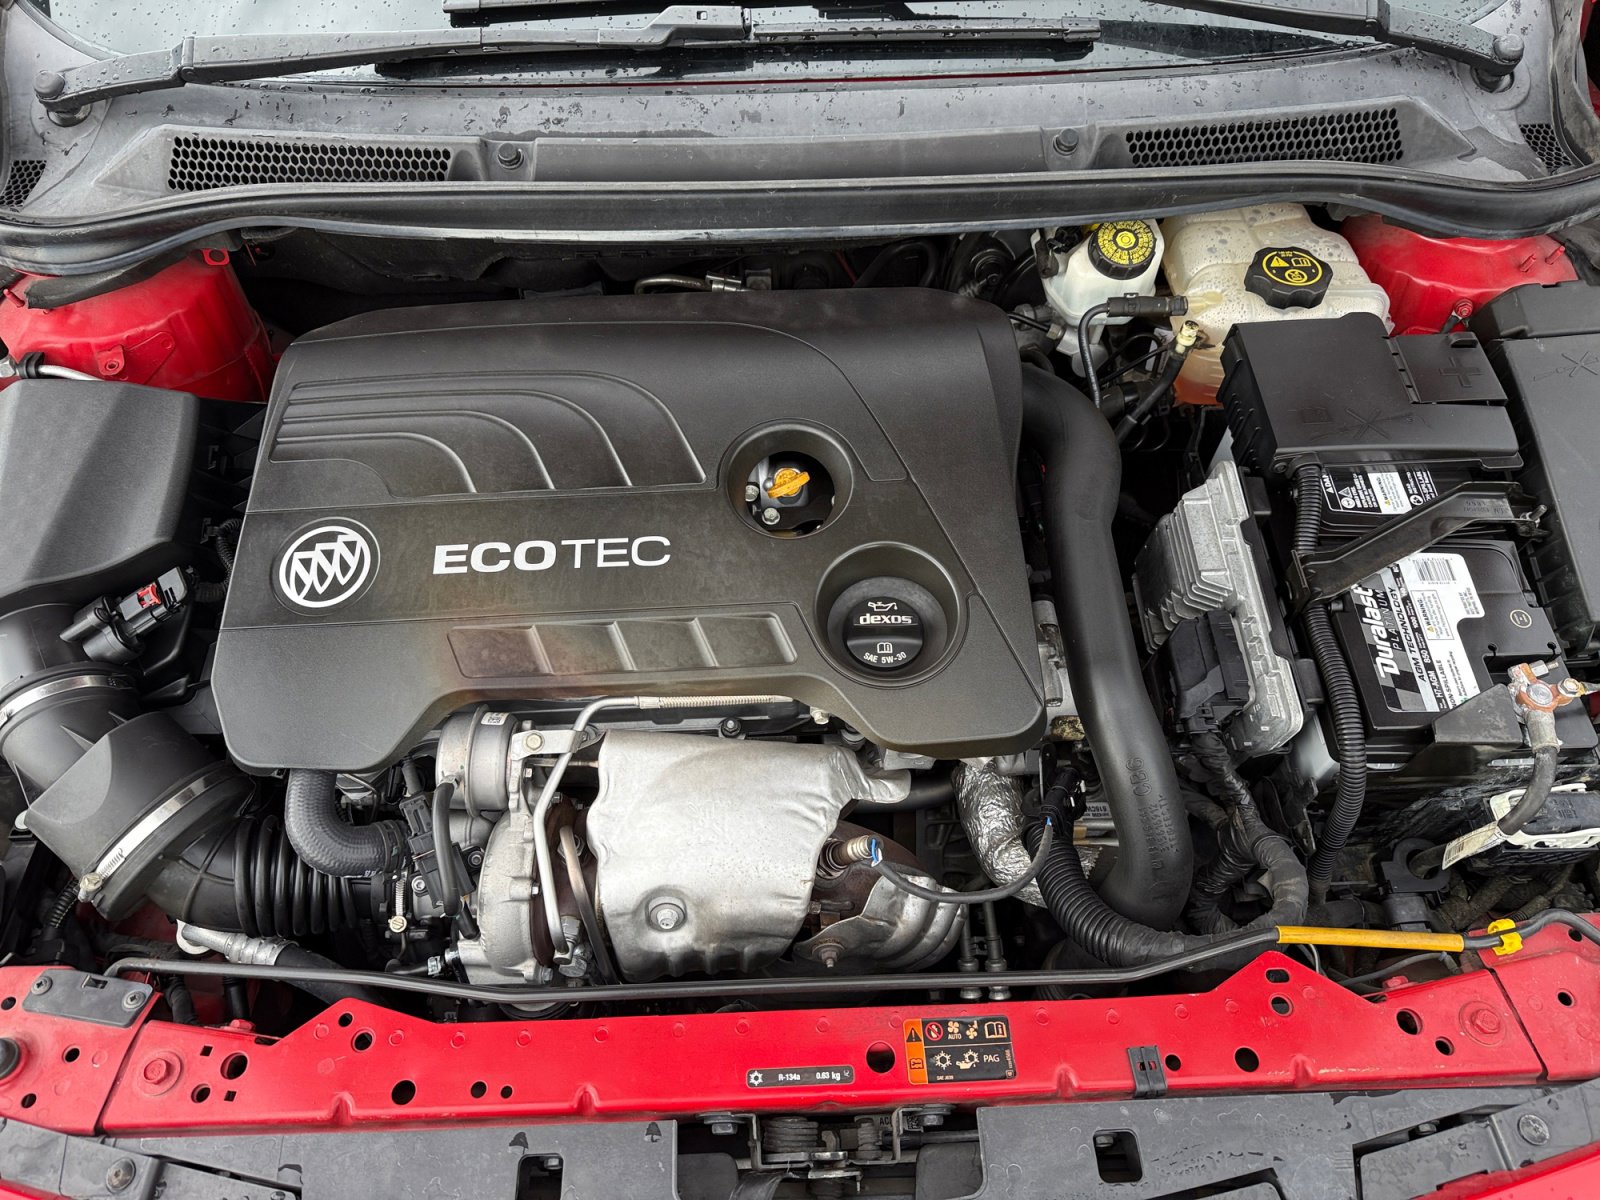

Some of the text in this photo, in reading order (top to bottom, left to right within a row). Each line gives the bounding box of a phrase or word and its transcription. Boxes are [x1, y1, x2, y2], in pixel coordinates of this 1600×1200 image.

[432, 535, 671, 575] ECOTEC
[860, 613, 913, 625] dexos
[1351, 583, 1400, 678] Duralast
[1375, 589, 1402, 650] PLATINUM
[1388, 587, 1416, 654] TECHNOLOGY
[863, 651, 907, 664] SAE 5W-30
[1412, 657, 1426, 682] AGM
[983, 1054, 1000, 1063] PAG
[778, 1072, 801, 1081] R-134a
[831, 1071, 841, 1081] kg
